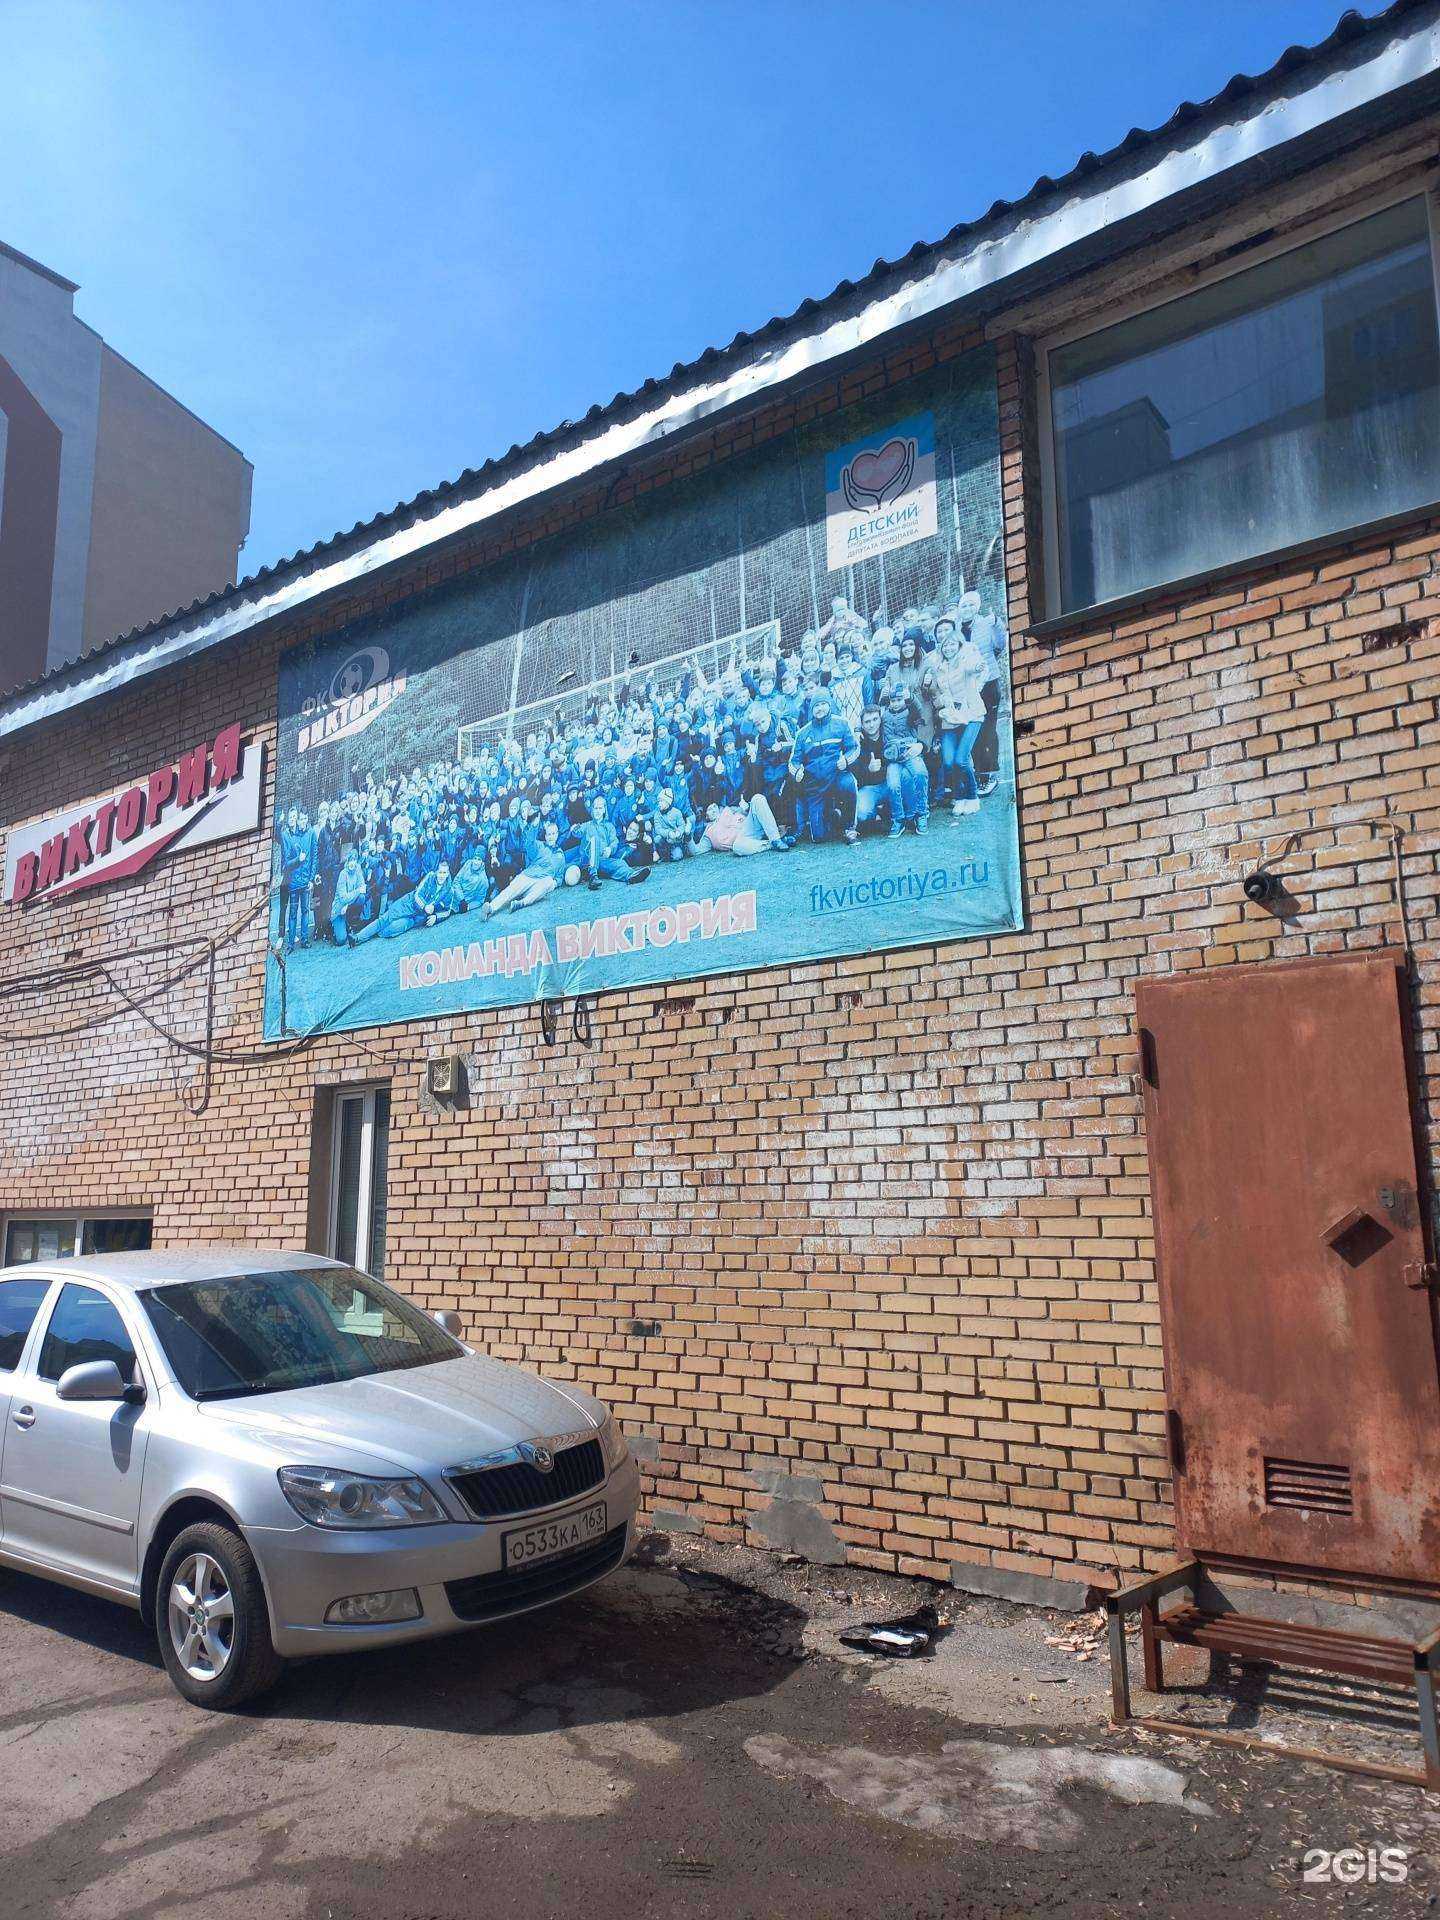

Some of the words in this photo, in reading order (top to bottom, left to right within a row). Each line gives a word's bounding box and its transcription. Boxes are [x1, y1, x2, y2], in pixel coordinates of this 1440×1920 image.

[848, 502, 918, 542] ДЕТСКИЙ
[298, 667, 407, 753] ВИКТОРИЯ
[302, 689, 329, 716] ФК
[12, 722, 241, 906] ВИКТОРИЯ
[809, 861, 989, 912] fkvictoriya.ru
[399, 930, 554, 991] КОМАНДА
[556, 889, 757, 964] ВИКТОРИЯ
